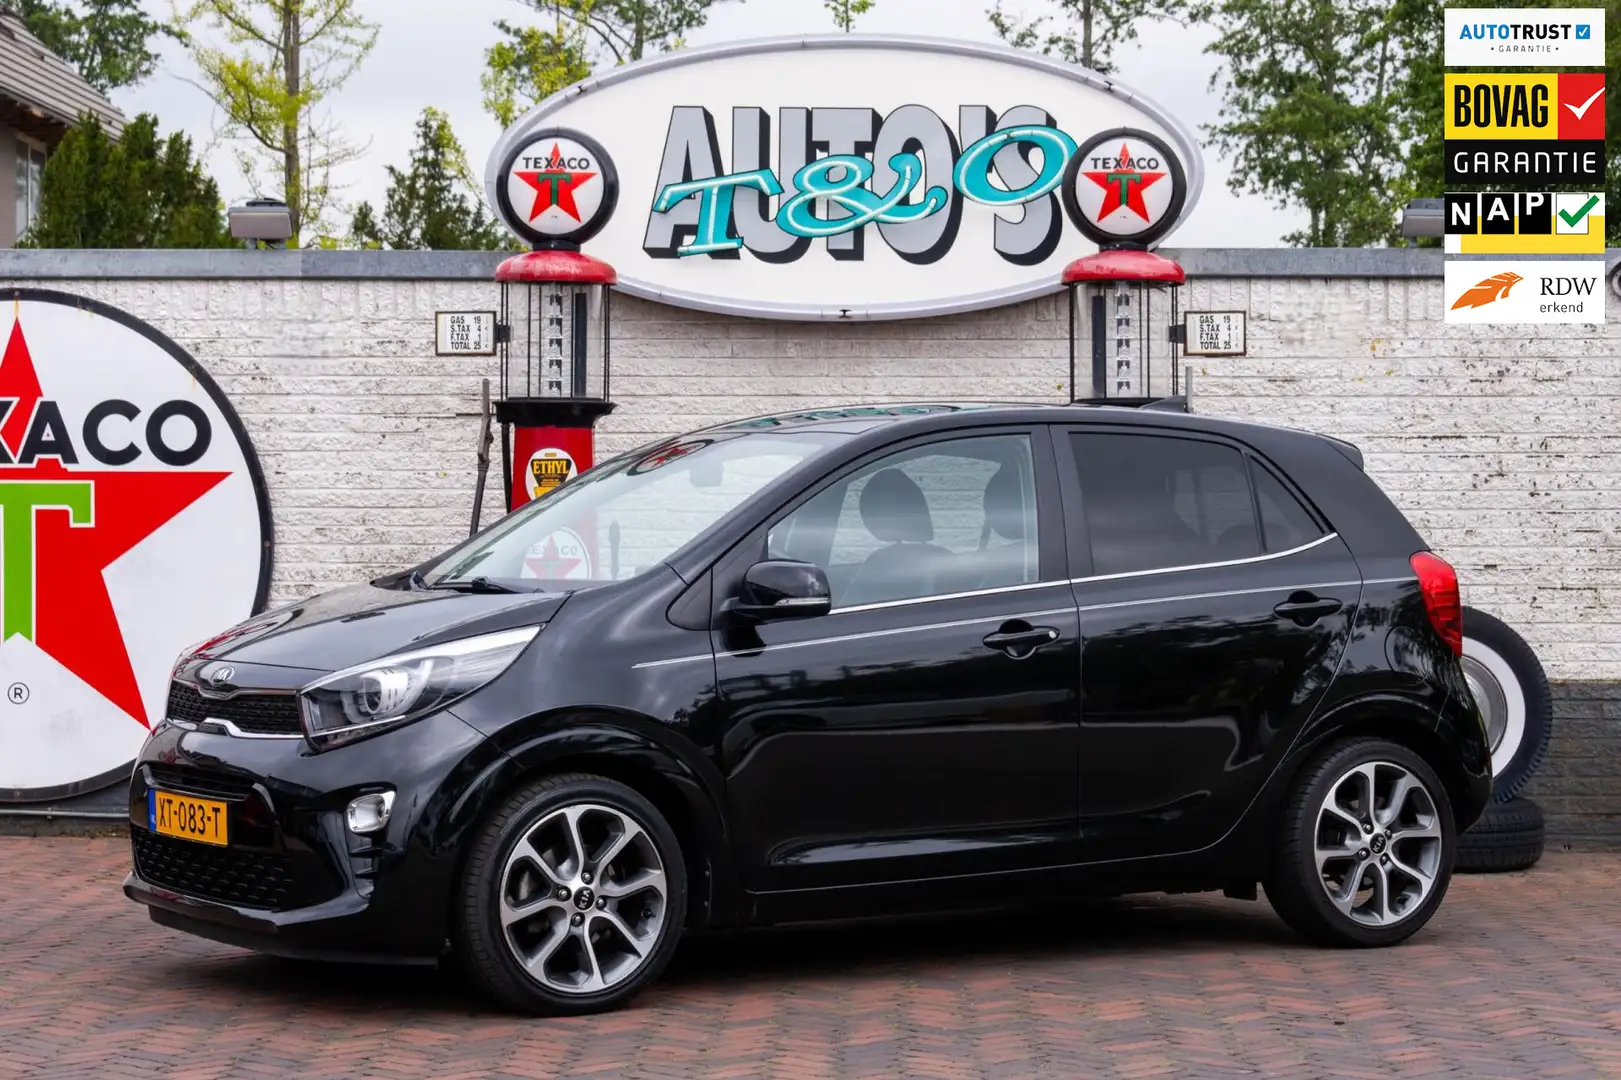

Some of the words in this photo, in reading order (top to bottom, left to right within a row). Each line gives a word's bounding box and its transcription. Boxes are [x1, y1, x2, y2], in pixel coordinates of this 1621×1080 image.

[523, 157, 590, 170] TEXACO
[1091, 157, 1159, 170] TEXACO
[450, 316, 465, 324] GAS
[473, 316, 482, 324] 19
[1199, 315, 1214, 324] GAS
[1223, 315, 1231, 324] 19
[450, 325, 470, 333] S.TAX
[1199, 324, 1220, 333] S.TAX
[450, 342, 471, 350] TOTAL
[473, 342, 482, 350] 25
[1200, 341, 1221, 350] TOTAL
[1223, 341, 1232, 350] 25
[0, 399, 212, 466] ACO
[532, 460, 569, 474] ETHYL
[159, 796, 221, 837] XT-083-T
